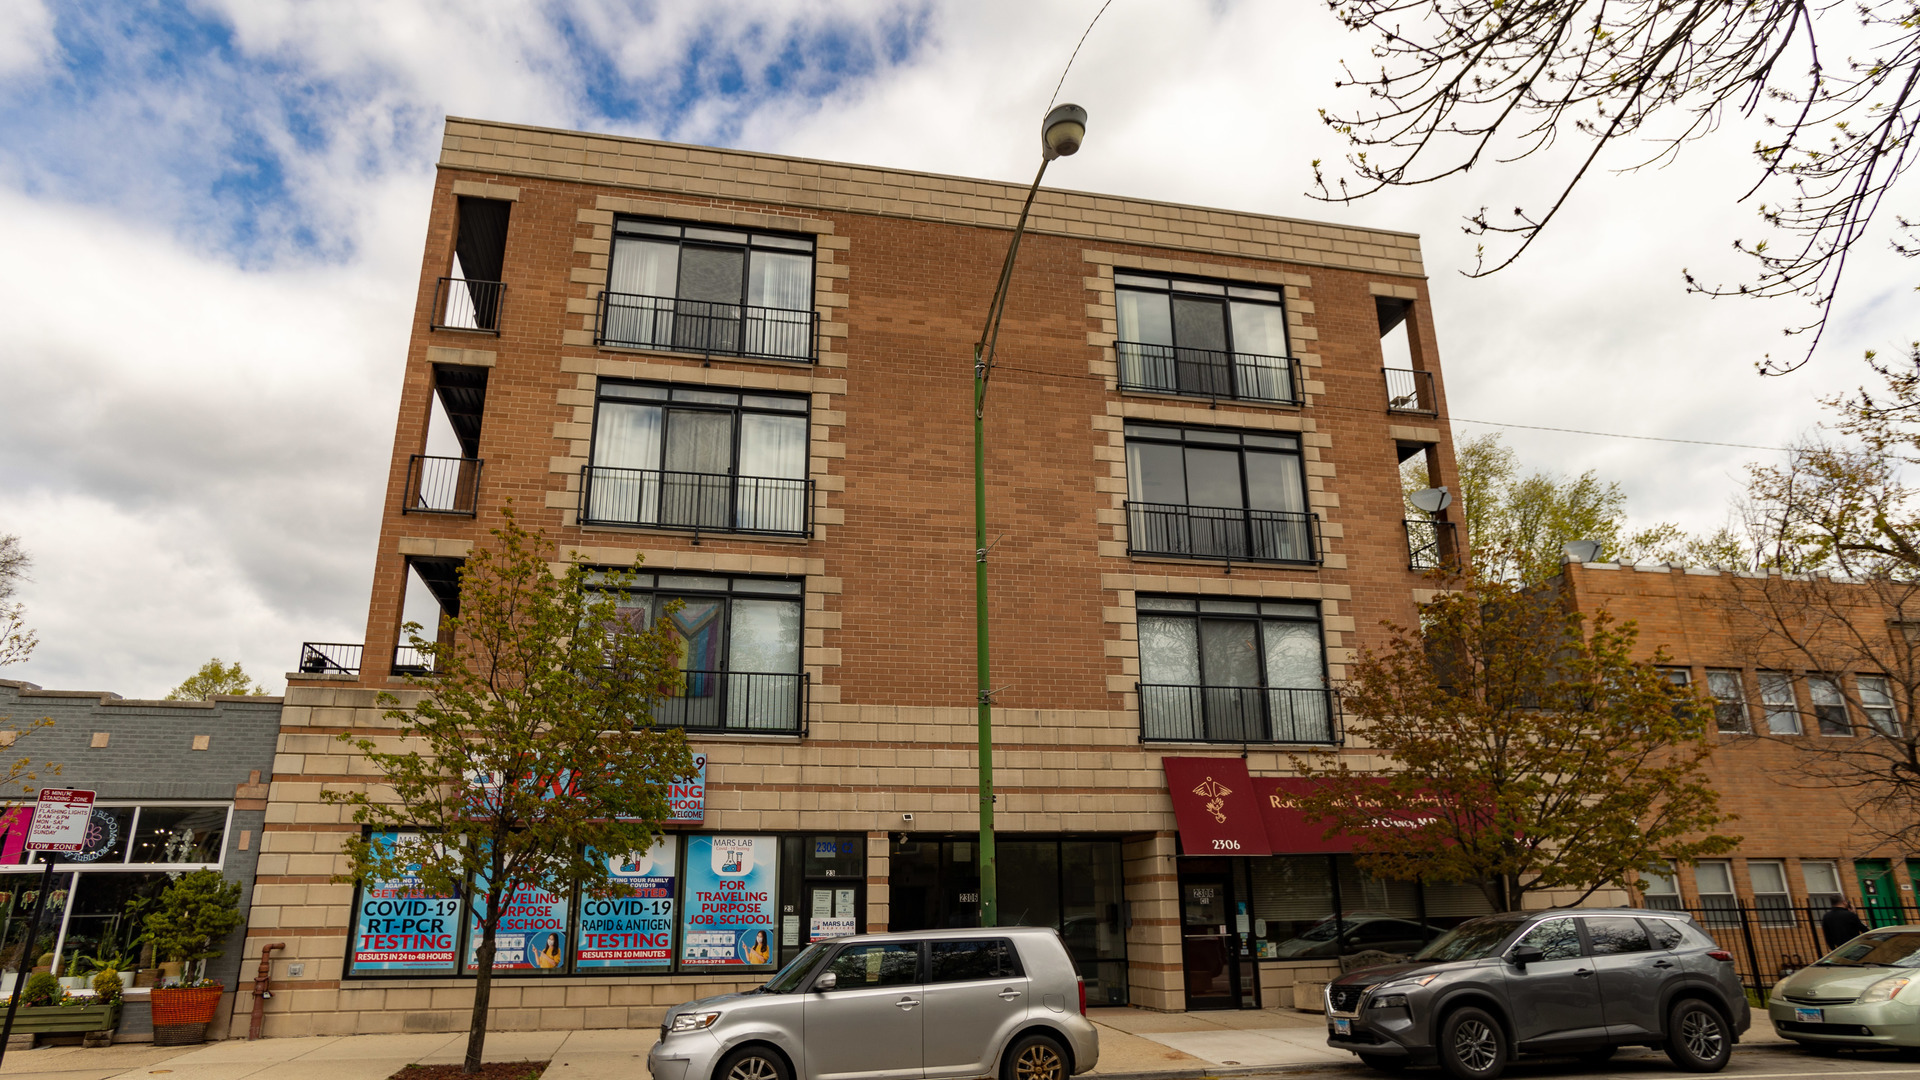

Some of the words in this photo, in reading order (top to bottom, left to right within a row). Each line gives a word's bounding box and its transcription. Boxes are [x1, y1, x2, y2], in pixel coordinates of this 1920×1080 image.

[670, 800, 704, 810] HOOL
[816, 842, 837, 852] 2306
[841, 842, 854, 854] C2
[1212, 839, 1240, 849] 2306
[720, 880, 745, 890] FOR
[372, 889, 398, 898] GET
[404, 889, 453, 898] TES
[484, 893, 559, 904] TAVELING
[696, 892, 768, 902] TRAVELING
[364, 901, 457, 916] COVID-19
[497, 906, 552, 916] URPOSE
[584, 901, 672, 916] COVID-19
[702, 904, 761, 913] PURPOSE
[367, 919, 444, 933] RT-PCR
[474, 919, 504, 931] JB,
[506, 919, 563, 930] SCHOOL
[582, 920, 614, 931] RAPID
[616, 919, 623, 931] &
[625, 919, 671, 931] ANTIGEN
[688, 915, 717, 926] JOB,
[720, 915, 773, 924] SCHOOL
[360, 934, 452, 950] TESTING
[585, 933, 668, 948] TESTING
